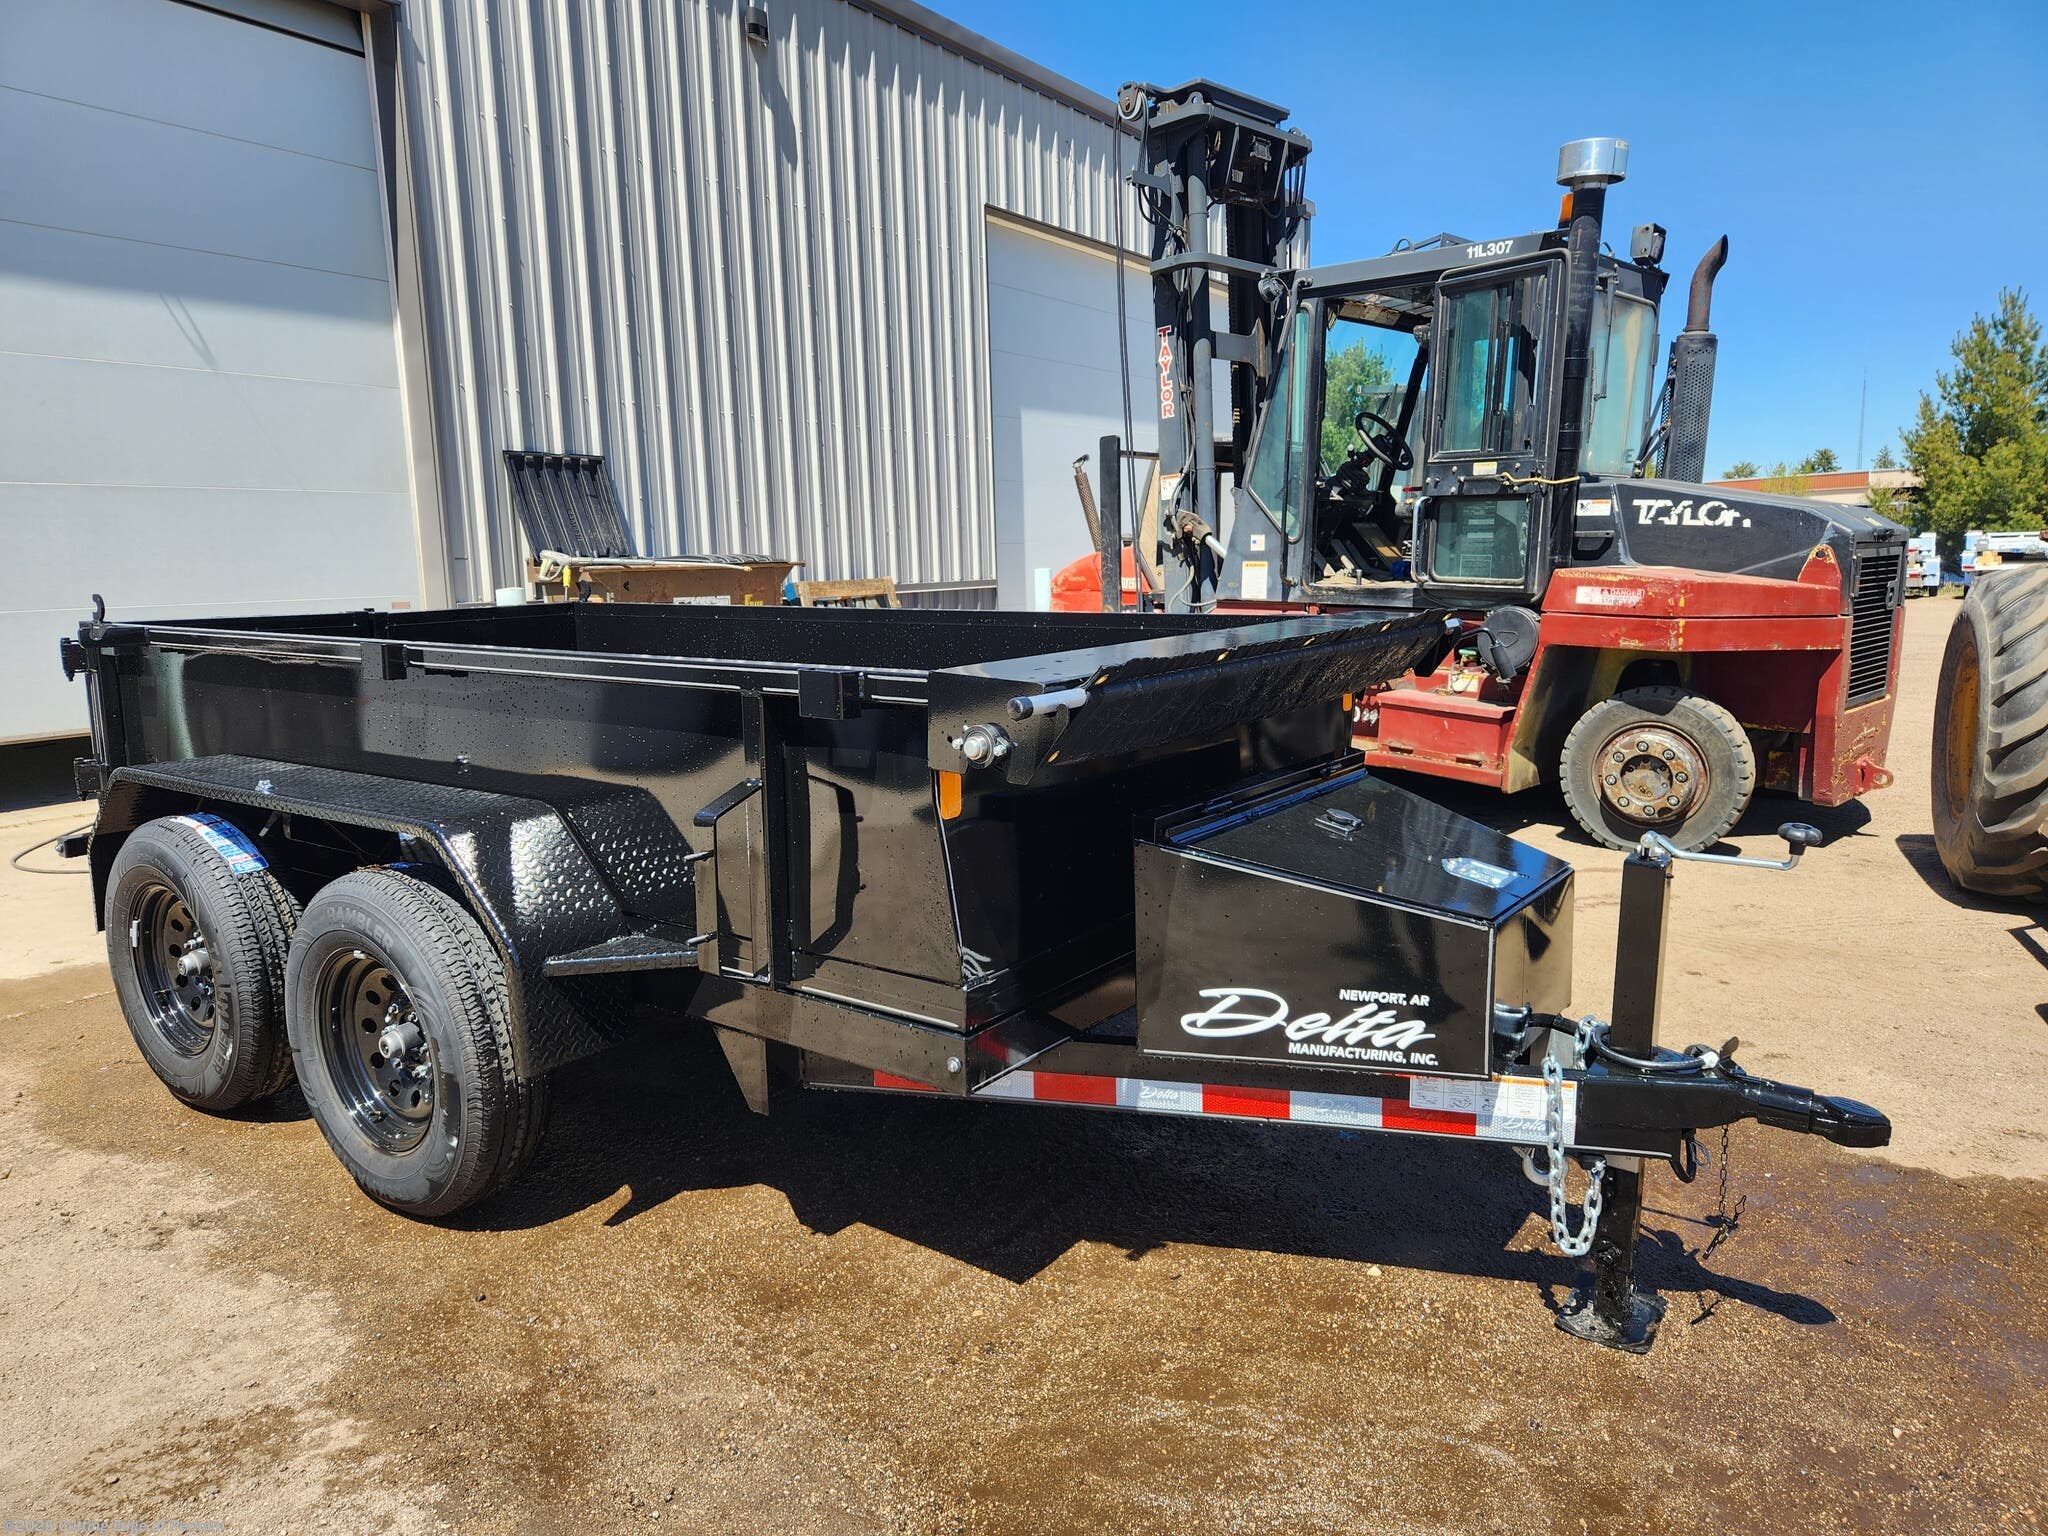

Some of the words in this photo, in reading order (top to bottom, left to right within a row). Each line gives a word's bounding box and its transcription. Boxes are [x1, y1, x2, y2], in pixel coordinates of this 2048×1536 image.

[1466, 240, 1514, 259] 11L307
[1157, 325, 1175, 419] TAYLOR
[326, 905, 396, 951] RAMBLER
[1339, 989, 1408, 1006] NEWPORT,
[1410, 995, 1431, 1007] AR
[1180, 988, 1437, 1051] Delta
[1288, 1042, 1407, 1065] MANUFACTURING,
[1410, 1052, 1440, 1066] INC.
